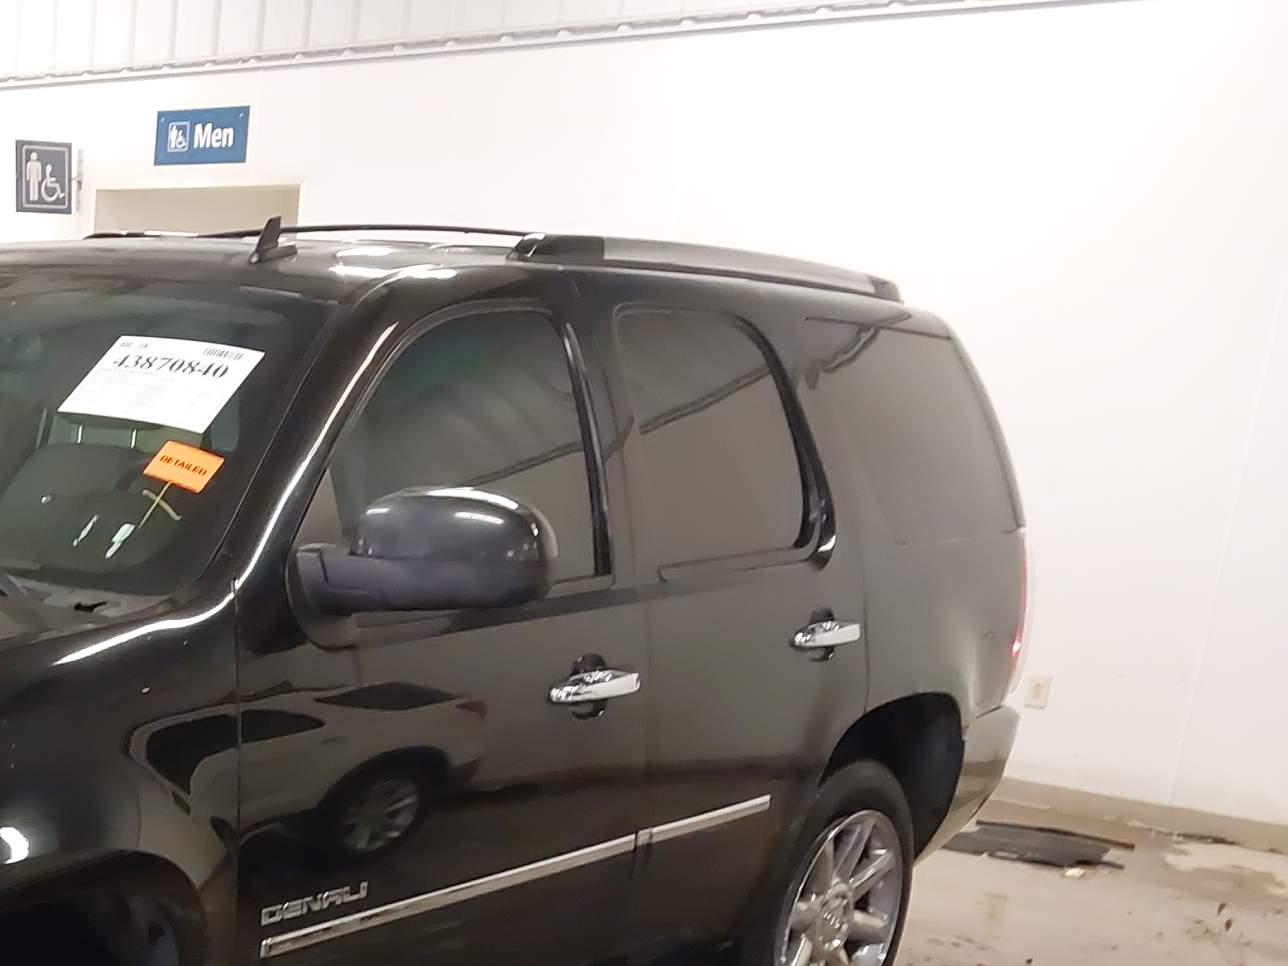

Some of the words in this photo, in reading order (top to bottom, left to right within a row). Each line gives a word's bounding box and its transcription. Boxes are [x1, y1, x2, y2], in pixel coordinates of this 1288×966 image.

[193, 122, 234, 149] Men
[113, 354, 230, 379] 43870840
[159, 454, 208, 476] DETAILED
[260, 880, 369, 927] DENALI
